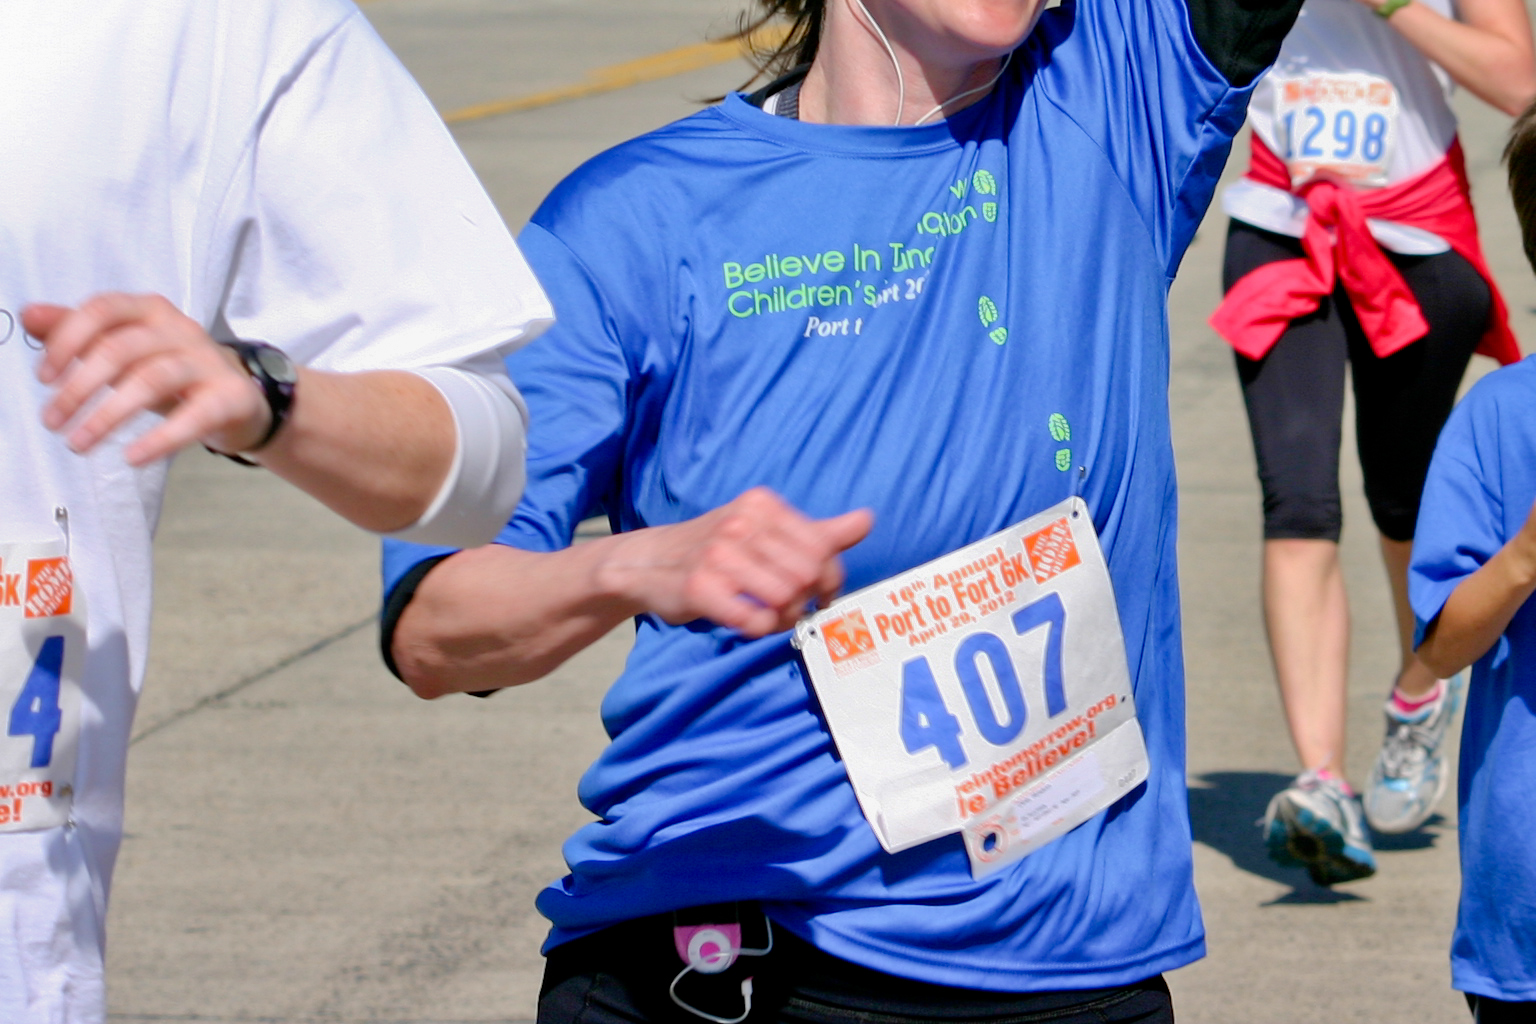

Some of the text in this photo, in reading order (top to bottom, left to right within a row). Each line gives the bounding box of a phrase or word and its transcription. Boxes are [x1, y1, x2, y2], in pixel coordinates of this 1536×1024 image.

[1284, 106, 1387, 163] 1298
[723, 248, 847, 289] Believe
[853, 242, 883, 273] In
[727, 279, 878, 318] Children's
[803, 316, 849, 339] Port
[932, 546, 1005, 591] Annual
[873, 552, 1033, 644] Port to Fort 6K
[7, 635, 65, 769] 4
[898, 590, 1070, 771] 407
[991, 719, 1097, 801] Believe!
